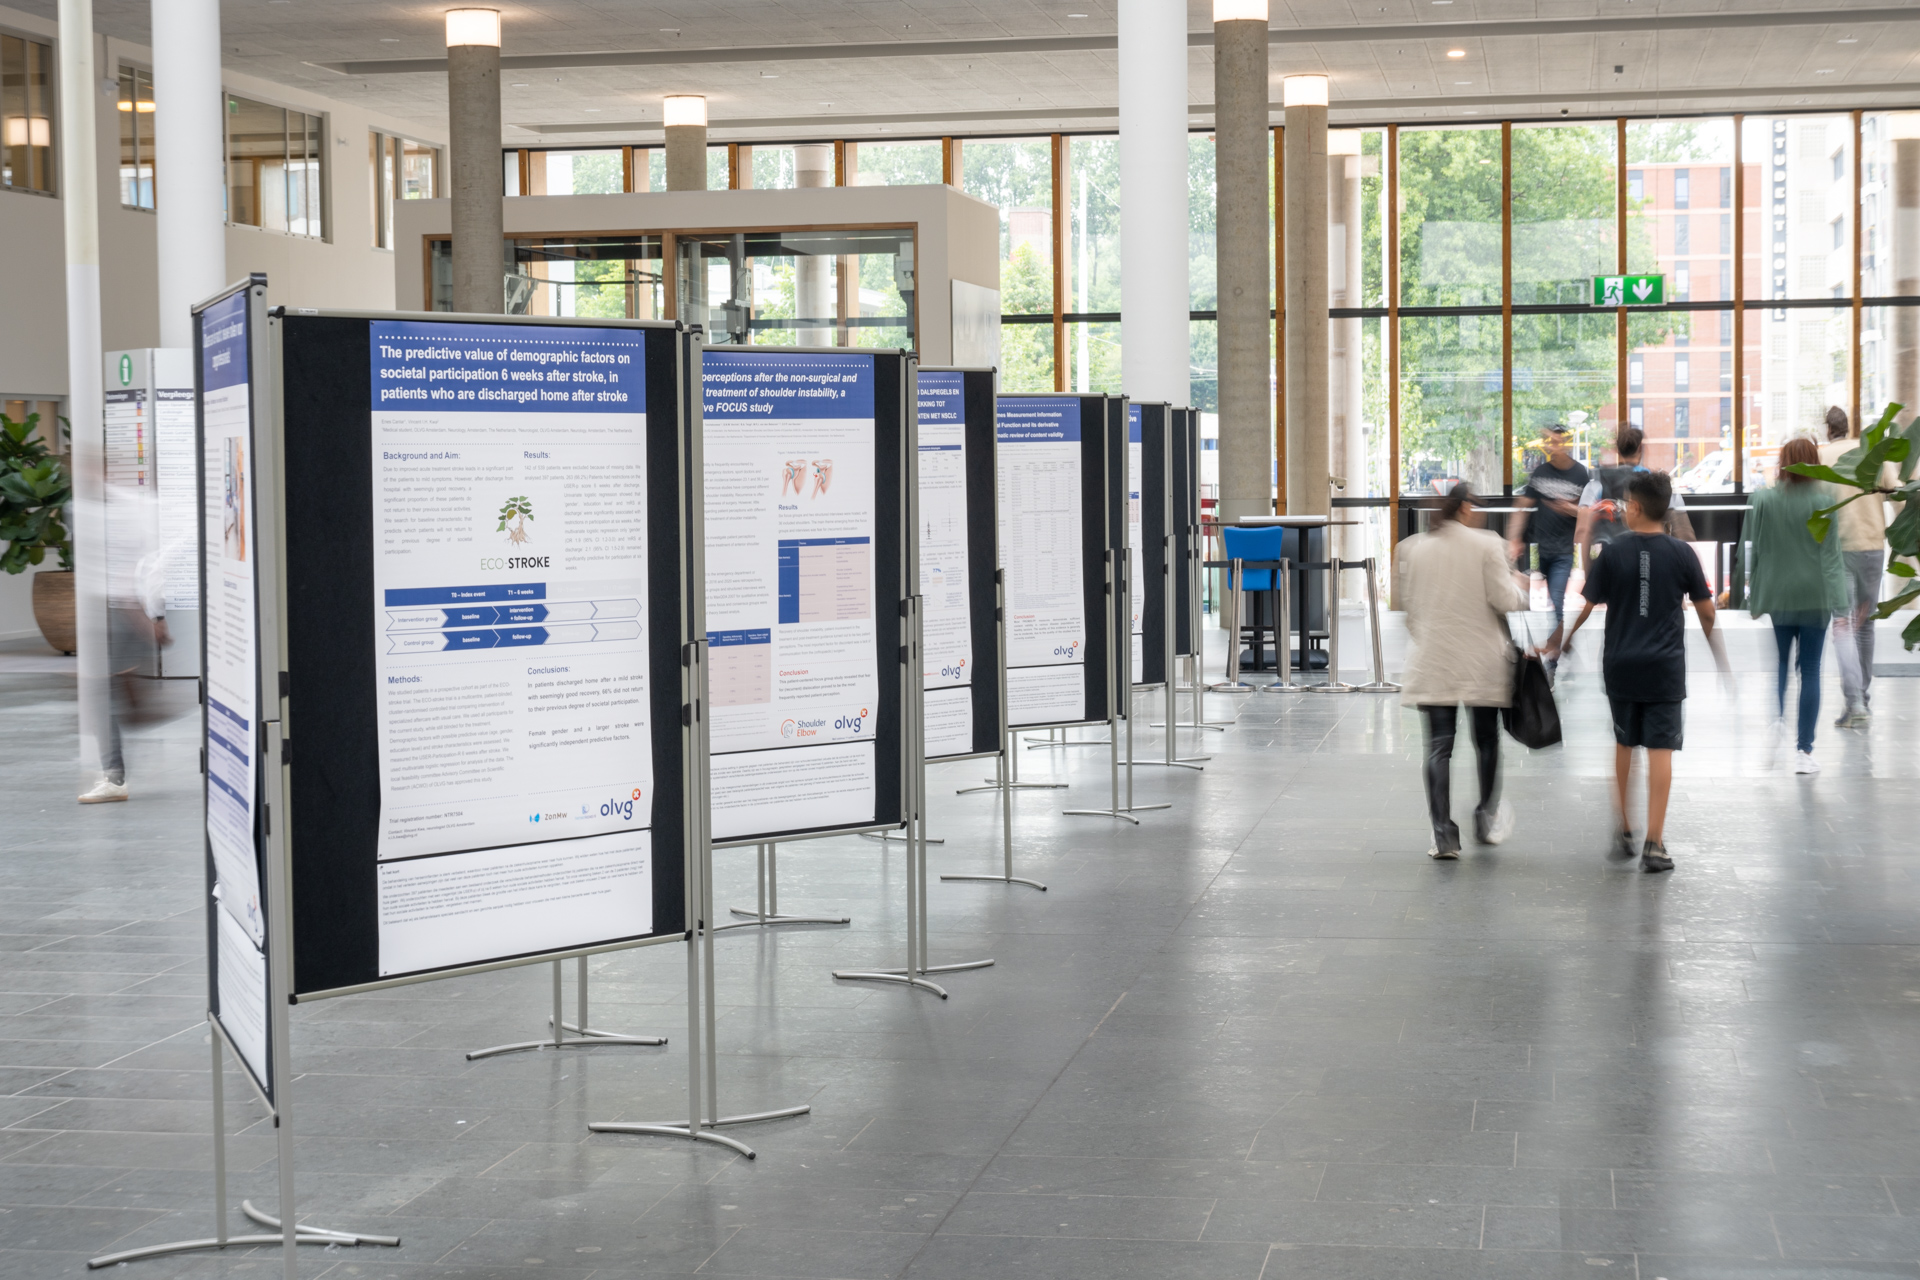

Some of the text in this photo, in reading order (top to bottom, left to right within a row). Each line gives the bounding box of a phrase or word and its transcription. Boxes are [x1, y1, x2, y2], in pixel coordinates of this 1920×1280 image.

[1774, 121, 1786, 232] STUDENT
[379, 345, 630, 364] The predictive value of demographic factors on
[380, 367, 618, 384] societal participation 6 weeks after stroke, in
[754, 372, 774, 382] after
[775, 372, 789, 382] the
[790, 373, 841, 384] non-surgical
[842, 373, 857, 382] and
[381, 387, 628, 403] patients who are discharged home after stroke
[706, 388, 748, 397] treatment
[749, 387, 759, 397] of
[759, 388, 797, 397] shoulder
[798, 388, 838, 399] instability,
[716, 402, 748, 412] FOCUS
[750, 403, 774, 414] study
[383, 452, 428, 461] Background
[481, 557, 550, 570] ECO-STROKE
[1054, 646, 1074, 658] olvg
[528, 666, 570, 675] Conclusions:
[942, 665, 960, 679] olvg
[388, 676, 422, 684] Methods:
[798, 719, 826, 728] Shoulder
[835, 716, 862, 732] olvg
[797, 728, 817, 737] Elbow
[529, 741, 558, 750] significantly
[600, 798, 633, 820] olvg
[545, 812, 567, 821] ZonMw
